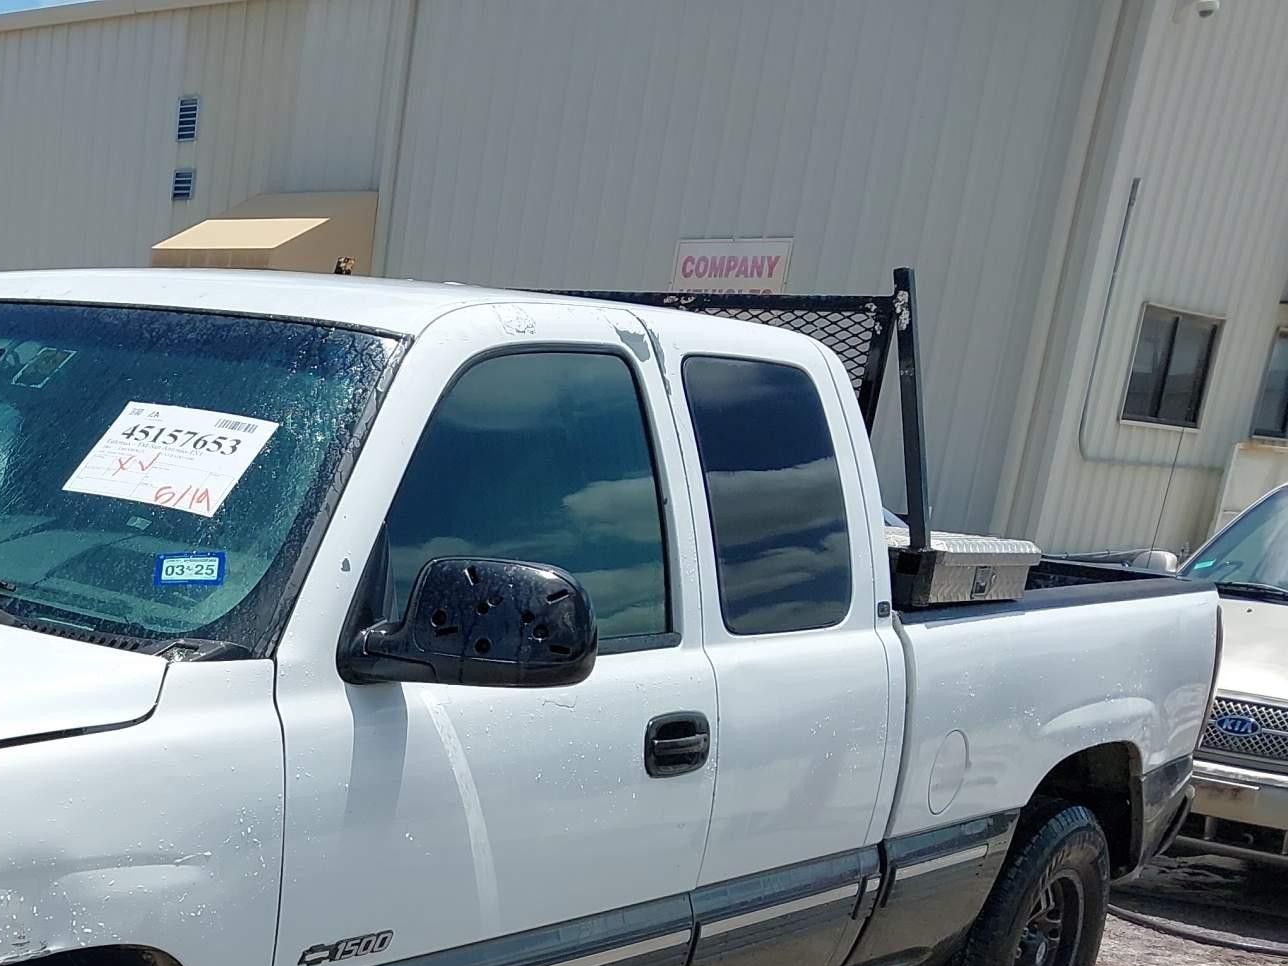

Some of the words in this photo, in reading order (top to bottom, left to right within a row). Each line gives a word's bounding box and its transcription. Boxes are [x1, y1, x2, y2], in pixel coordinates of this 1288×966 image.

[680, 255, 780, 279] COMPANY
[120, 423, 242, 456] 45157653
[1222, 718, 1253, 733] KIA
[334, 930, 394, 961] 1500
